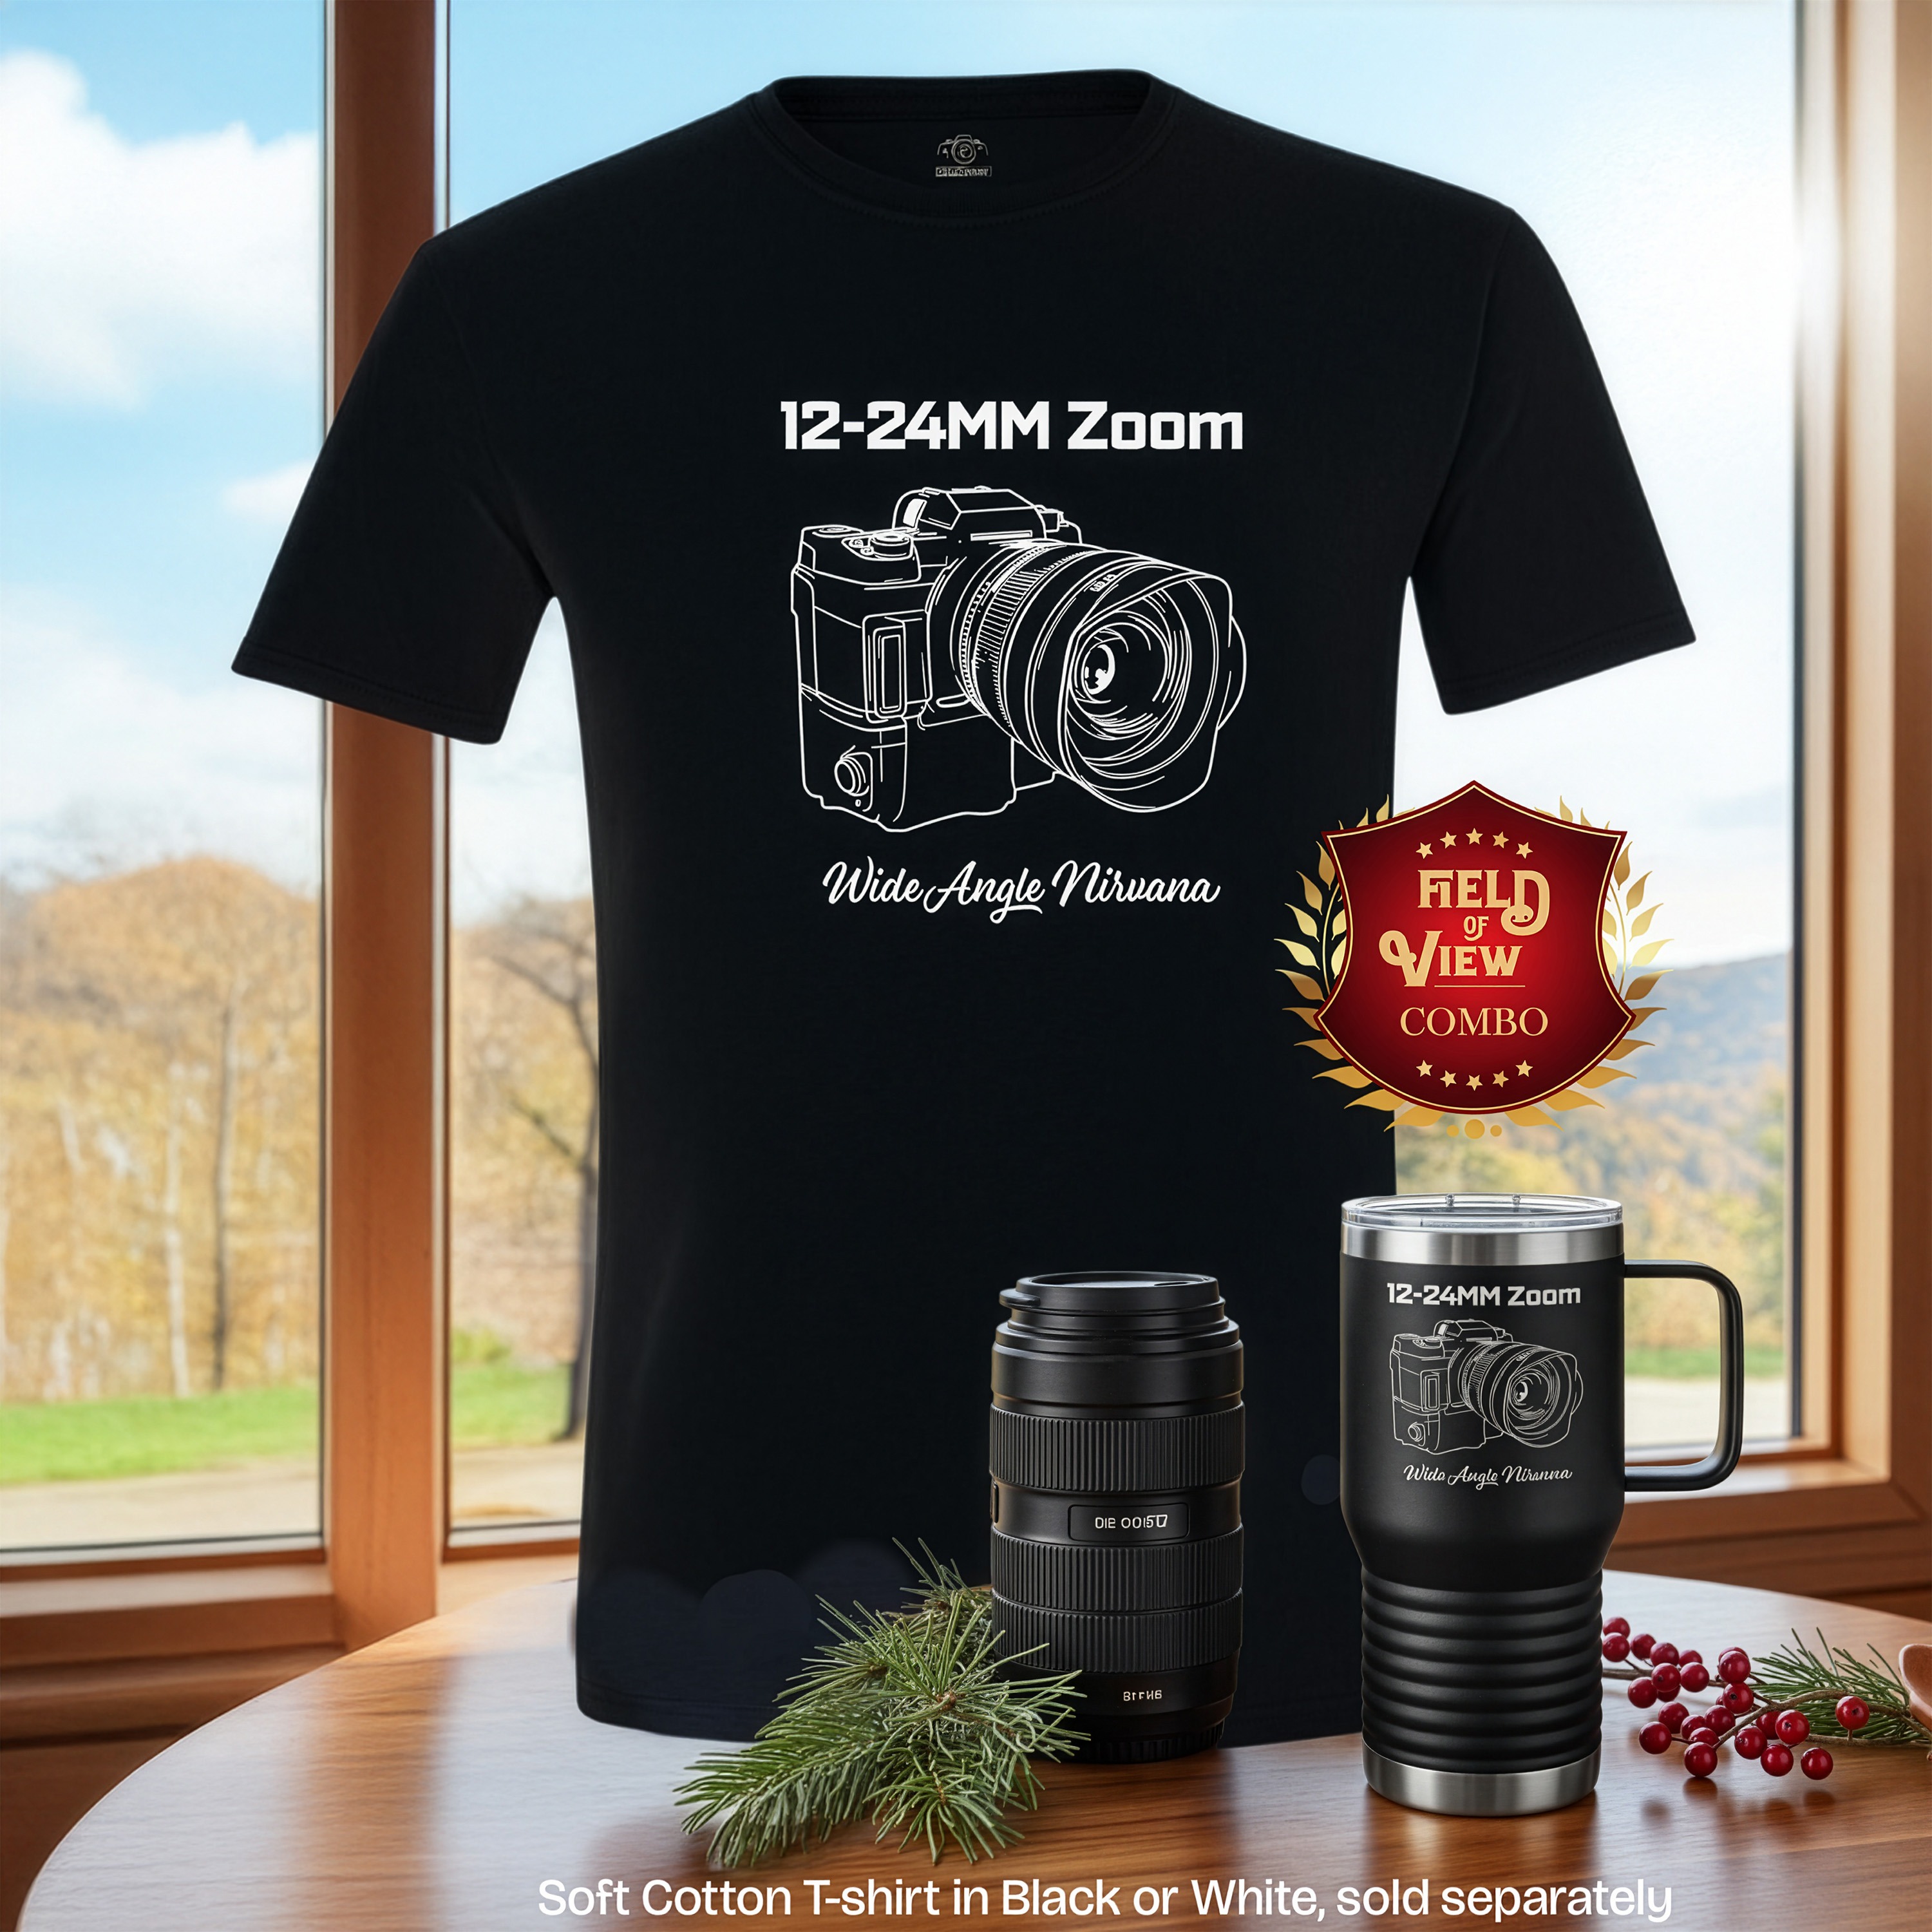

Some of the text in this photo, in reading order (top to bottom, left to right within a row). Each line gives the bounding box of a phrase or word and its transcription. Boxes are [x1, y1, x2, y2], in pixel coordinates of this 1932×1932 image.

[781, 401, 1243, 450] 12-24MM Zoom
[822, 855, 1221, 924] Wide Angle Nirvana
[1387, 1282, 1581, 1306] 12-24MM Zoom
